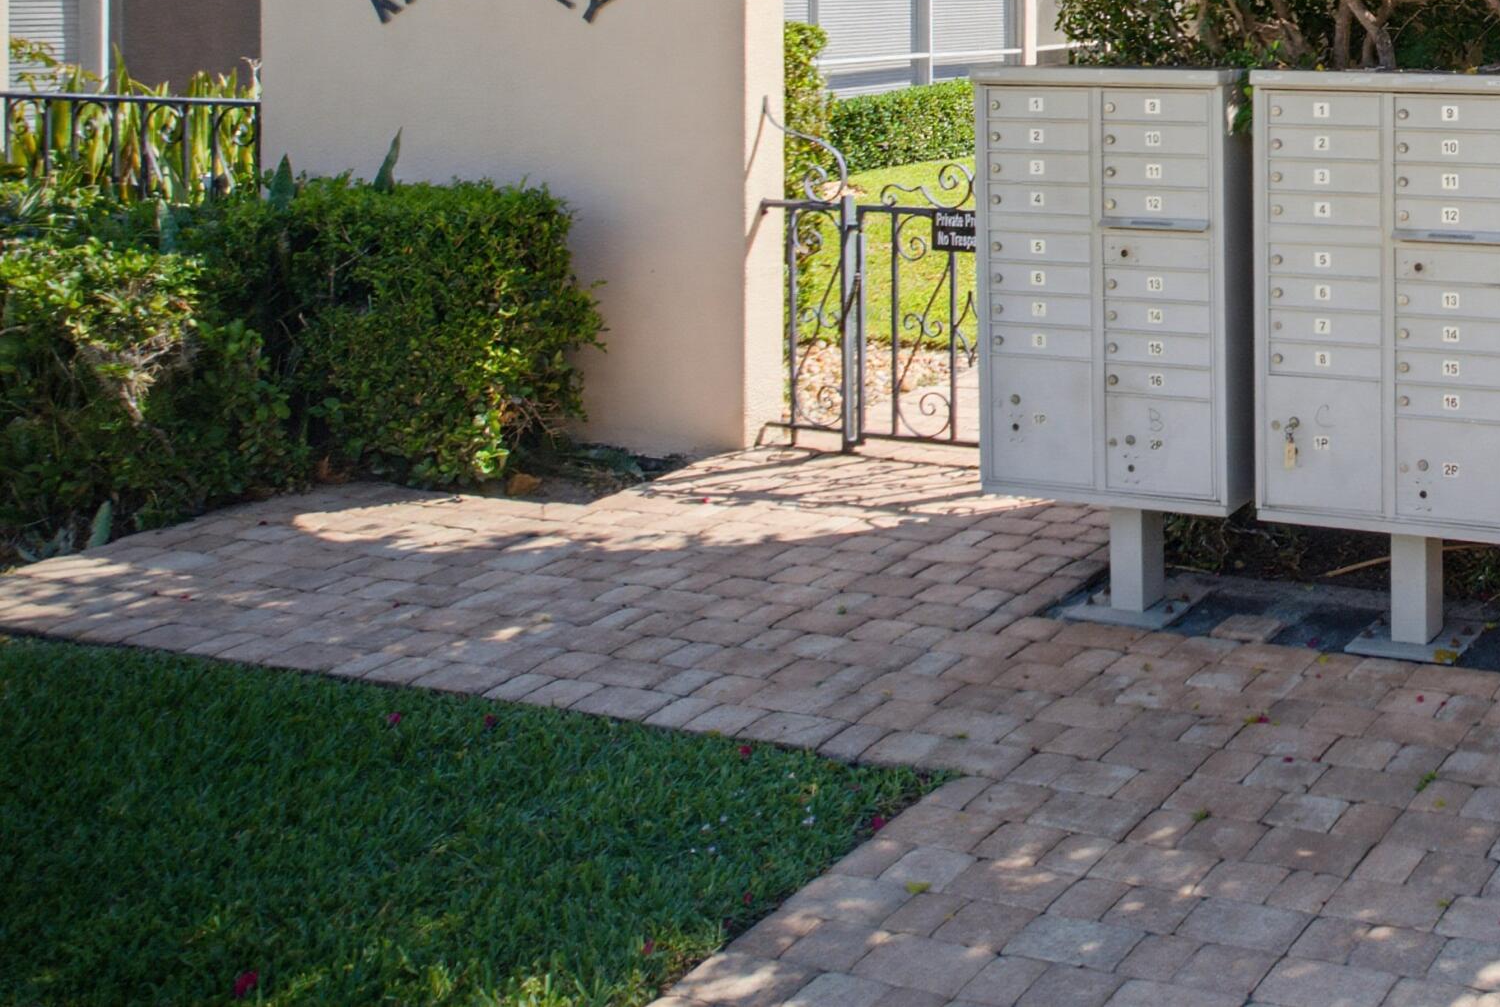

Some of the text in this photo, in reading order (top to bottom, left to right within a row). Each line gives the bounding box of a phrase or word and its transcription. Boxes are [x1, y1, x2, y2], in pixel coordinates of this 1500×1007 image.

[1146, 134, 1160, 144] 10
[1443, 142, 1457, 153] 10
[1148, 166, 1159, 176] 11
[1444, 176, 1456, 187] 11
[1148, 198, 1160, 209] 12
[936, 212, 963, 227] Private
[1444, 210, 1458, 221] 12
[937, 231, 949, 245] No
[1149, 279, 1161, 290] 13
[1445, 295, 1457, 307] 13
[1149, 311, 1161, 321] 14
[1445, 329, 1457, 340] 14
[1149, 343, 1162, 355] 15
[1445, 363, 1458, 375] 15
[1150, 375, 1162, 387] 16
[1445, 397, 1458, 408] 16
[1316, 438, 1329, 450] 1P
[1444, 464, 1458, 476] 2P
